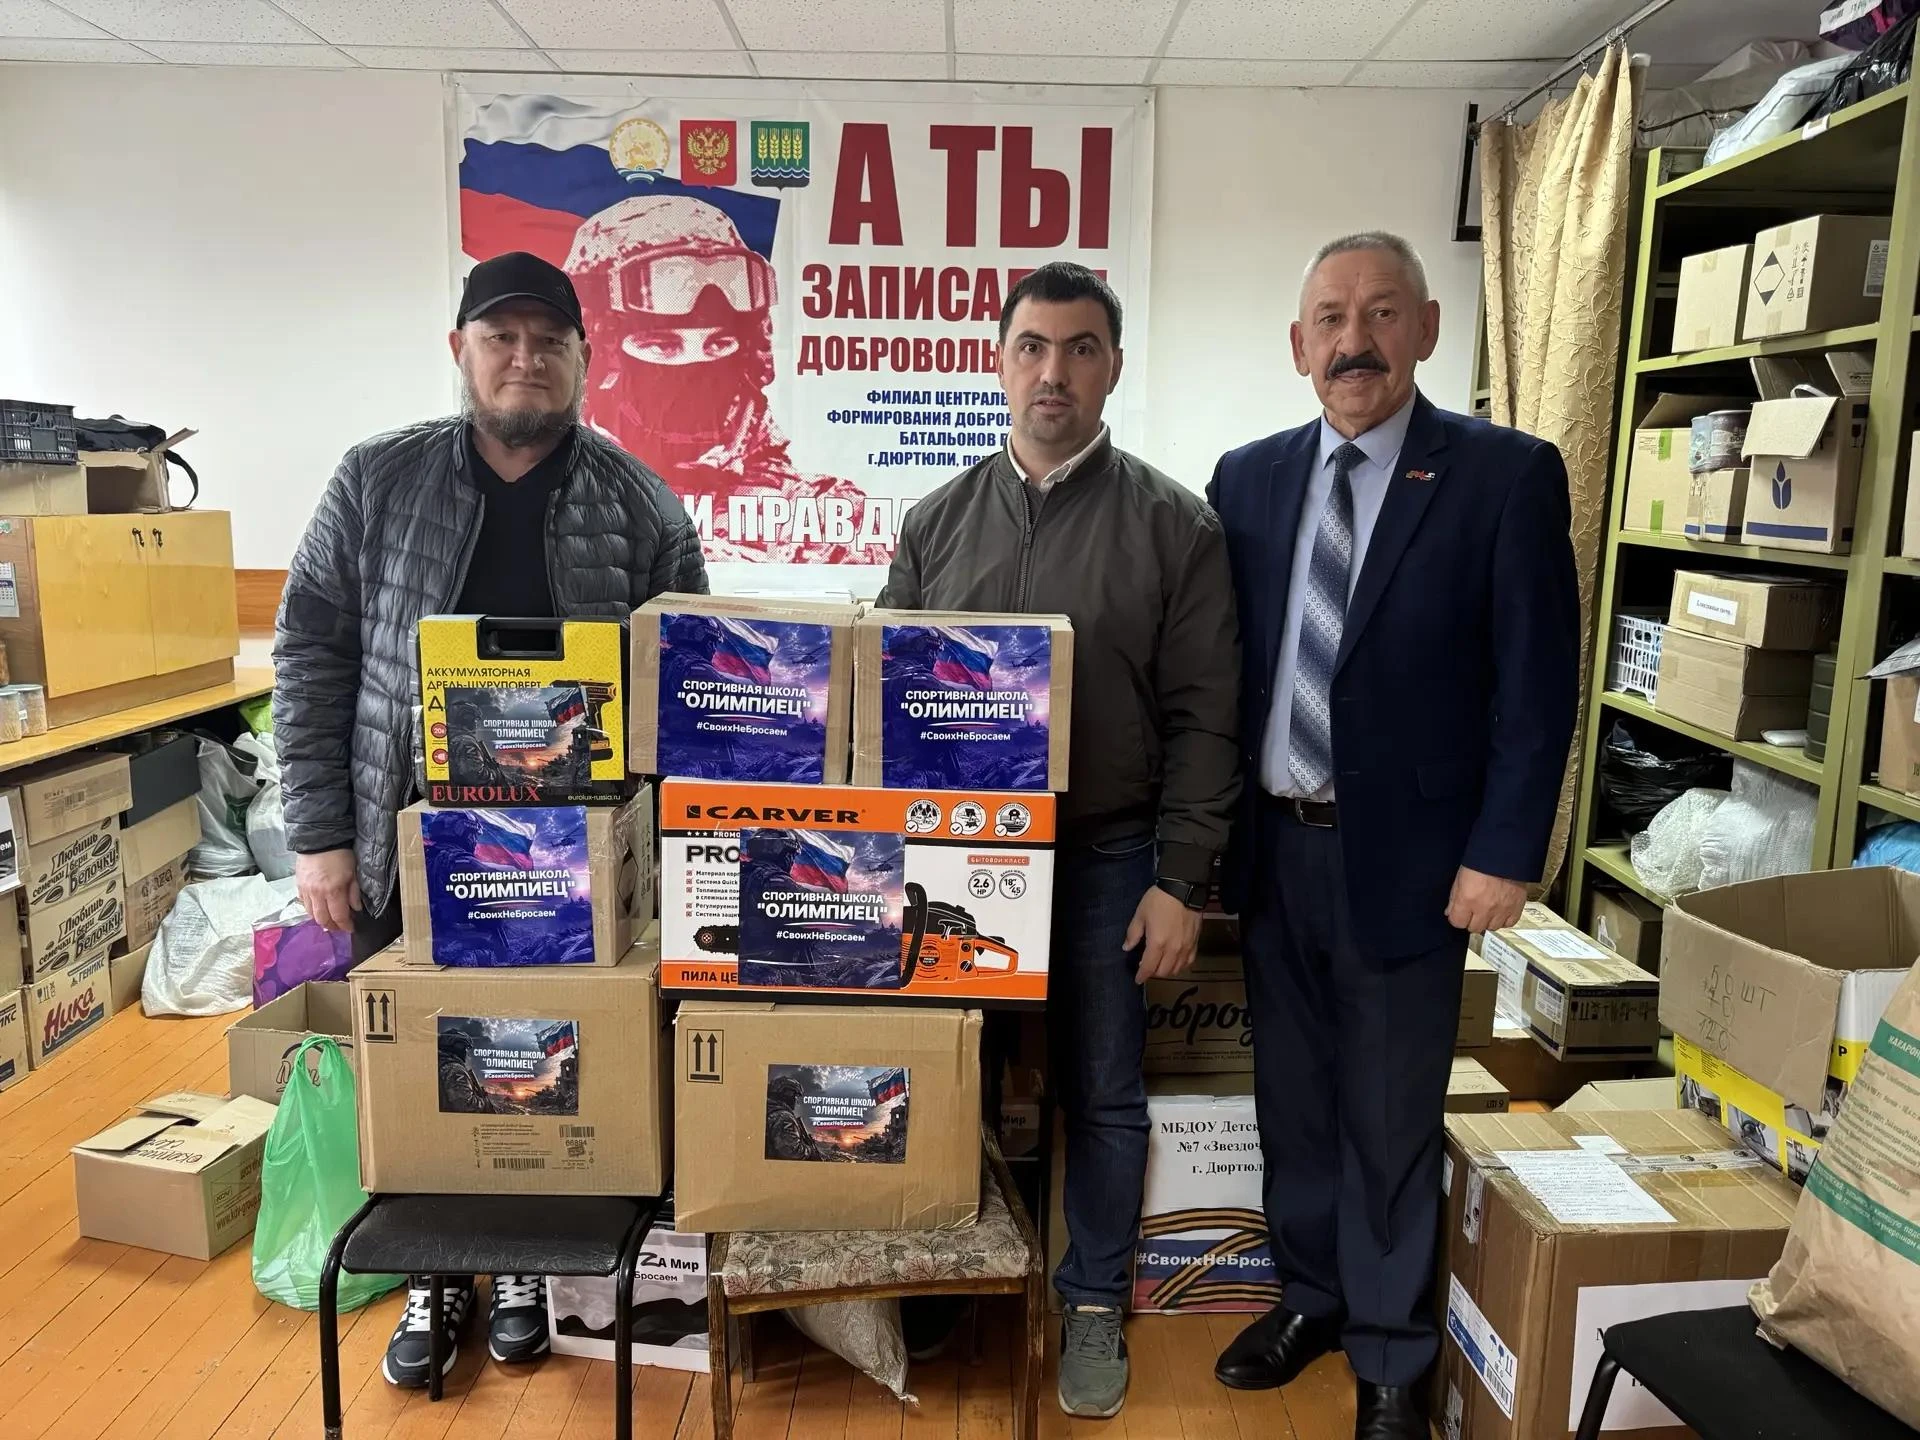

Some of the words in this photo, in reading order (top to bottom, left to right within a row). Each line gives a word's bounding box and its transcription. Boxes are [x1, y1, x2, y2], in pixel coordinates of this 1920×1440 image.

[828, 121, 904, 248] А
[929, 124, 1113, 250] ТЫ
[797, 335, 998, 376] ДОБРОВОЛЬ
[866, 390, 931, 406] ФИЛИАЛ
[935, 391, 1009, 408] ЦЕНТРАЛЬ
[827, 410, 951, 426] ФОРМИРОВАНИЯ
[954, 412, 1012, 428] ДОБРОВ
[899, 431, 996, 447] БАТАЛЬОНОВ
[867, 452, 960, 467] г.ДЮРТЮЛИ,
[426, 667, 531, 678] АККУМУЛЯТОРНАЯ
[683, 680, 762, 694] СПОРТИВНАЯ
[764, 685, 807, 698] ШКОЛА
[905, 690, 983, 701] СПОРТИВНАЯ
[986, 691, 1029, 701] ШКОЛА
[677, 691, 811, 718] "ОЛИМПИЕЦ"
[900, 702, 1033, 721] "ОЛИМПИЕЦ"
[483, 719, 530, 728] СПОРТИВНАЯ
[531, 719, 558, 728] ШКОЛА
[696, 721, 788, 737] #СвоихНеБросаем
[492, 728, 549, 740] "ОЛИМПИЕЦ"
[920, 731, 1011, 742] #СвоихНеБросаем
[431, 785, 541, 802] EUROLUX
[705, 806, 860, 824] CARVER
[449, 871, 527, 883] СПОРТИВНАЯ
[529, 870, 570, 880] ШКОЛА
[973, 878, 990, 888] 2.6
[446, 881, 576, 899] "ОЛИМПИЕЦ"
[762, 890, 840, 903] СПОРТИВНАЯ
[842, 891, 884, 904] ШКОЛА
[467, 908, 556, 920] #СвоихНеБросаем
[757, 901, 888, 922] "ОЛИМПИЕЦ"
[776, 929, 866, 943] #СвоихНеБросаем
[681, 971, 718, 982] ПИЛА
[720, 972, 738, 984] ЦЕ
[44, 987, 96, 1045] Ника
[473, 1048, 520, 1059] СПОРТИВНАЯ
[520, 1049, 546, 1060] ШКОЛА
[482, 1058, 538, 1070] "ОЛИМПИЕЦ"
[803, 1096, 850, 1107] СПОРТИВНАЯ
[850, 1097, 877, 1107] ШКОЛА
[811, 1105, 868, 1118] "ОЛИМПИЕЦ"
[1160, 1121, 1218, 1135] МБДОУ
[1220, 1120, 1260, 1134] Детск
[1176, 1141, 1200, 1153] №7
[1203, 1140, 1262, 1153] «Звездоч
[1191, 1163, 1203, 1175] г.
[1205, 1161, 1264, 1177] Дюртюл
[670, 1258, 699, 1272] Мир
[1135, 1252, 1276, 1267] #СвоихНеБрос
